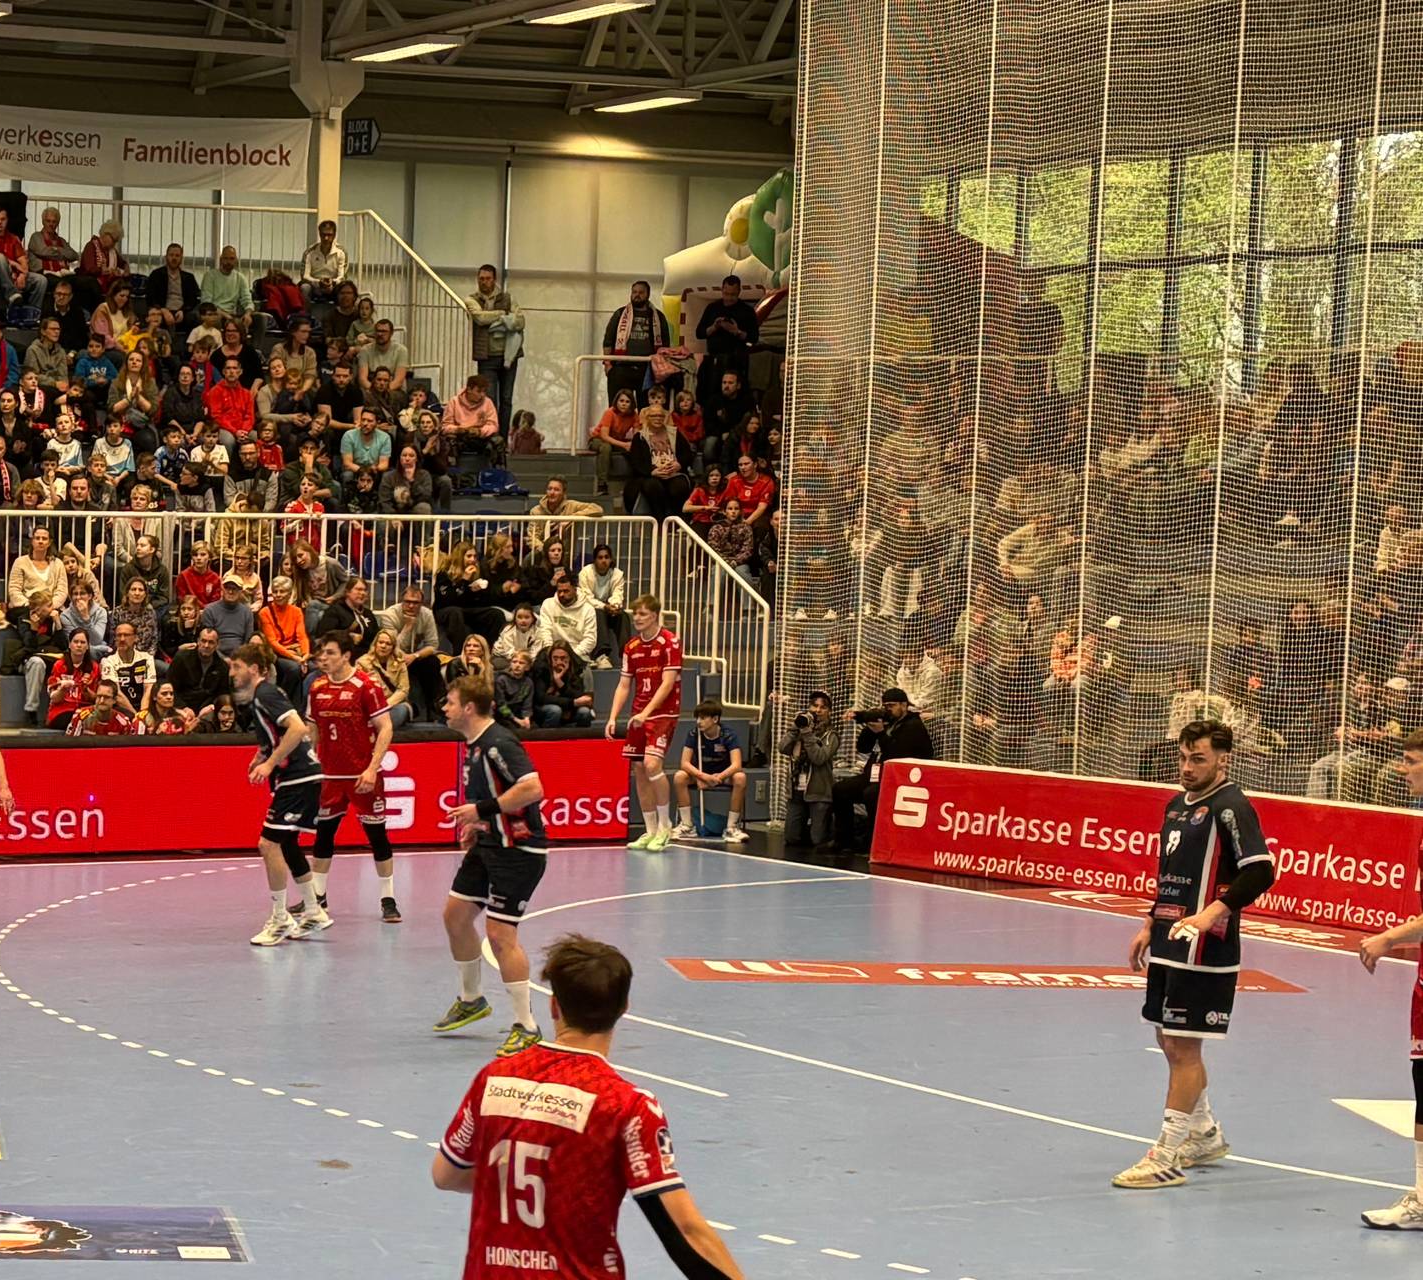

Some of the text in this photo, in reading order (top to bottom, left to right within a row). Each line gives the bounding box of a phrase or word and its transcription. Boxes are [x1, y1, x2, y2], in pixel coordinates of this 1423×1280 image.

[347, 120, 368, 133] BLOCK
[122, 137, 291, 168] Familienblock
[347, 134, 368, 154] D+E
[16, 148, 42, 163] sind
[44, 150, 99, 168] Zuhause.
[329, 723, 338, 741] 3
[937, 801, 1161, 857] Sparkasse Essen
[933, 849, 1158, 895] www.sparkasse-essen.de
[893, 968, 1148, 984] frame
[488, 1139, 553, 1229] 15
